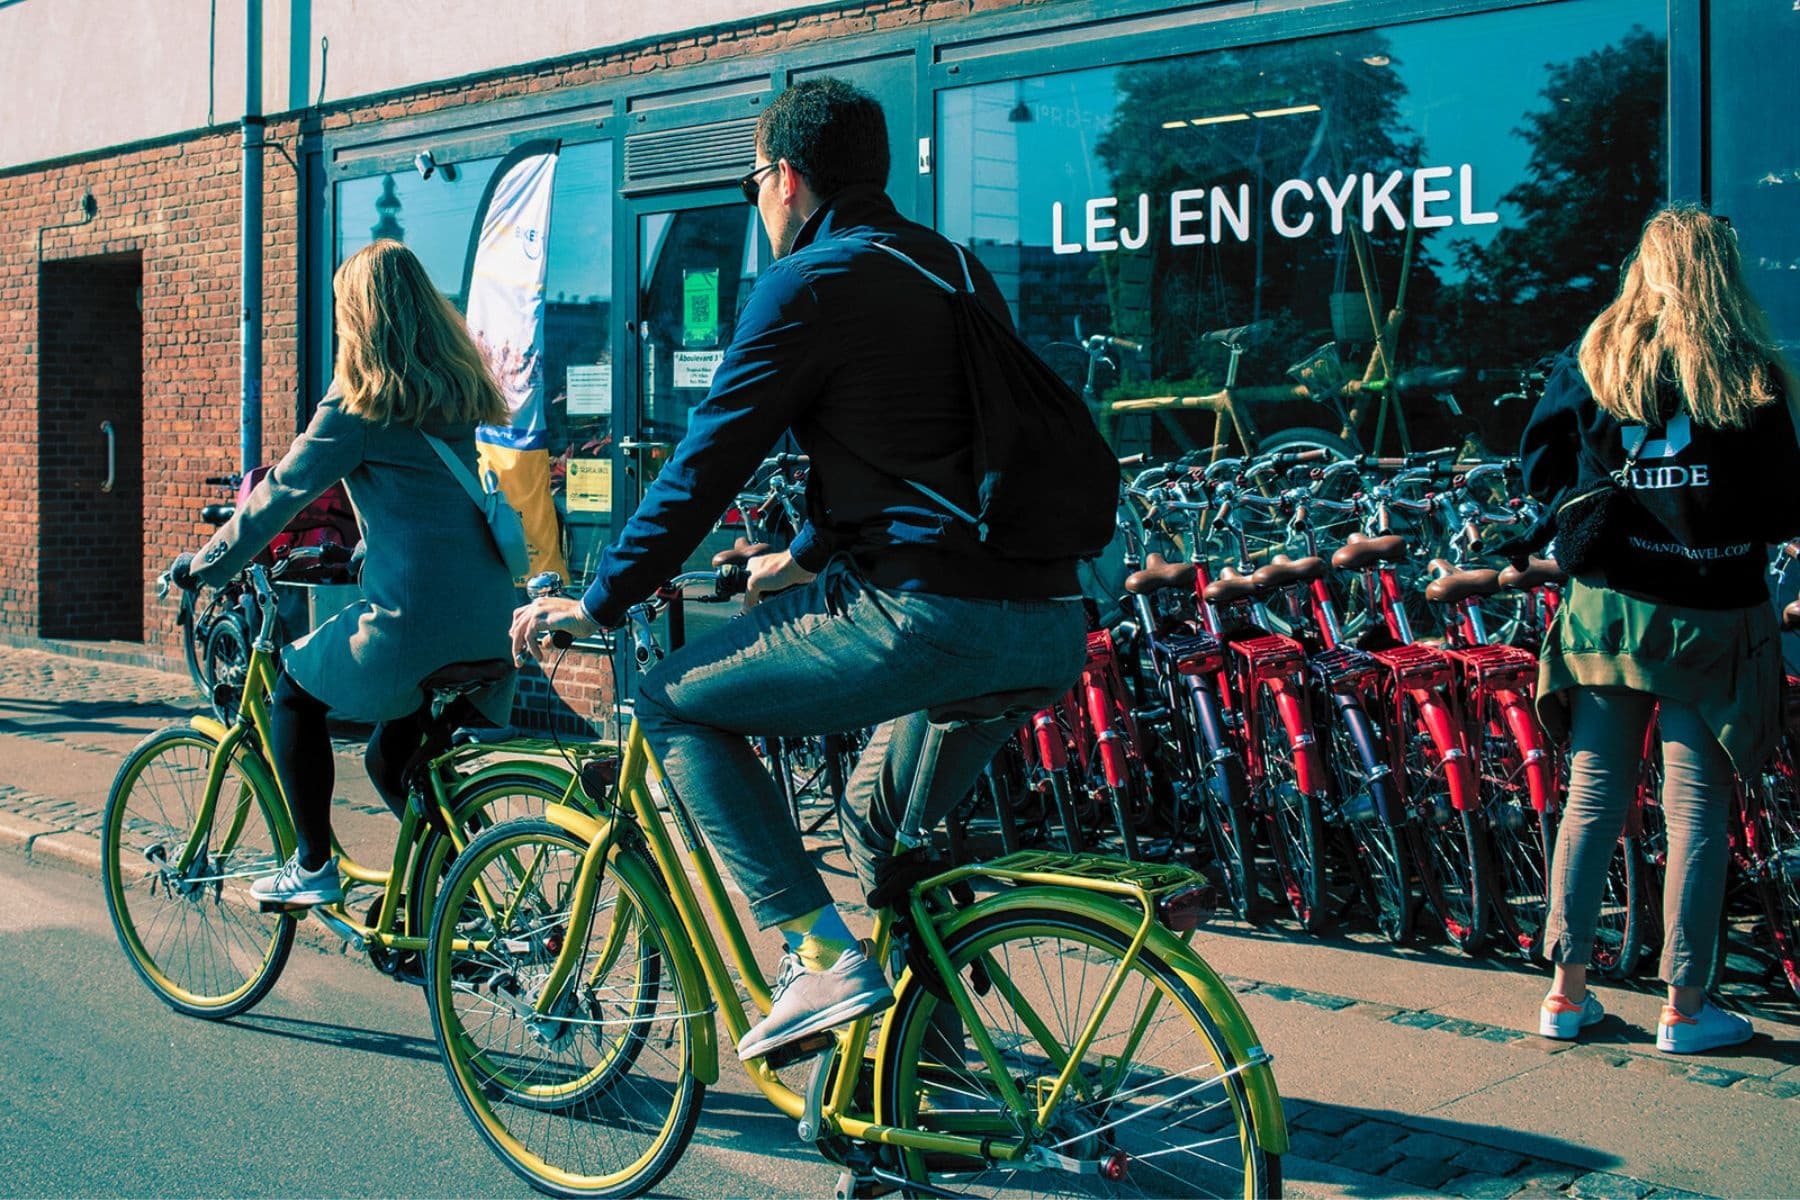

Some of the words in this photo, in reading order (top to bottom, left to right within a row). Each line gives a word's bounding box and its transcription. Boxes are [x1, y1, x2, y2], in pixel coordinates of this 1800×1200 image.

[1052, 193, 1149, 255] LEJ
[1170, 184, 1250, 246] EN
[1271, 163, 1500, 238] CYKEL
